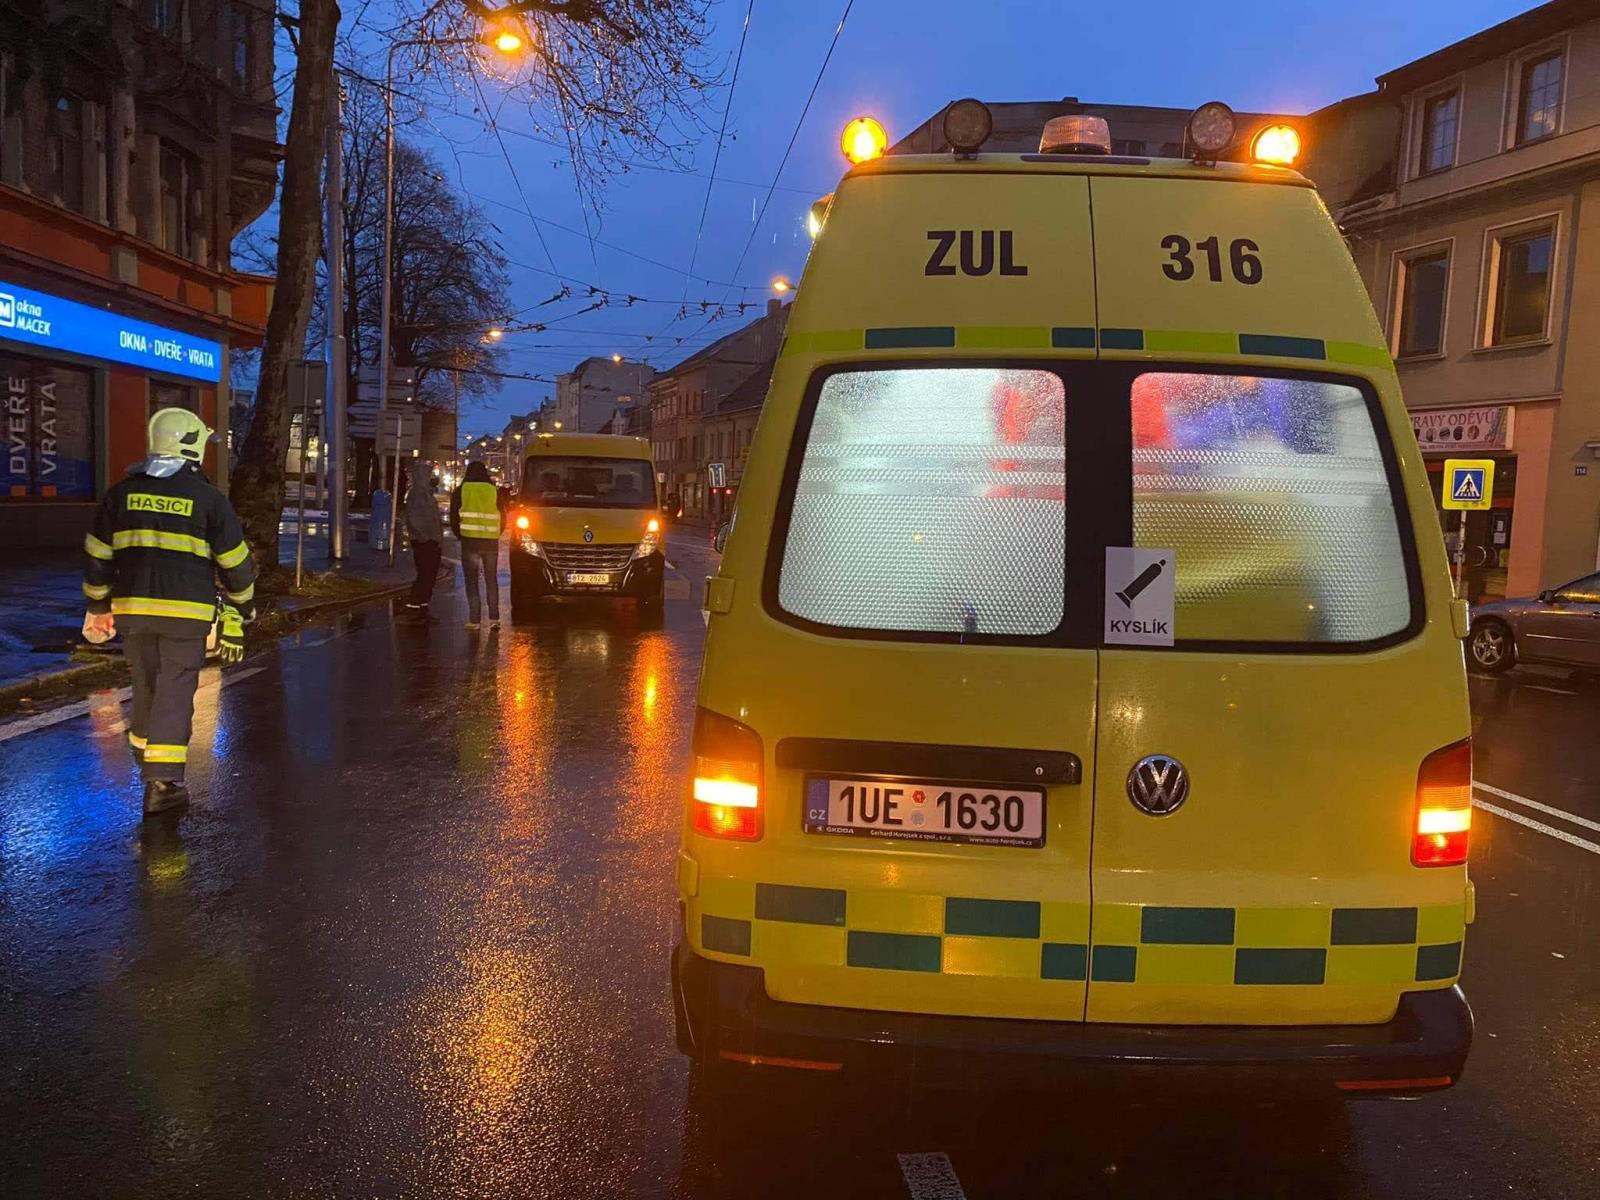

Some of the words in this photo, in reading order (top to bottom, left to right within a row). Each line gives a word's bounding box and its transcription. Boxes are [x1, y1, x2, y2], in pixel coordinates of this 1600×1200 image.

[925, 230, 1028, 276] ZUL
[1160, 234, 1264, 285] 316
[16, 299, 42, 317] okna
[15, 315, 51, 336] MACEK
[120, 330, 147, 353] OKNA
[154, 338, 182, 362] DVEŘE
[188, 347, 215, 369] VRATA
[41, 382, 57, 475] VRATA
[1110, 619, 1168, 635] KYSLÍK
[809, 809, 826, 820] CZ
[839, 786, 904, 826] 1UE
[936, 791, 1025, 833] 1630
[870, 829, 893, 837] Gerhard
